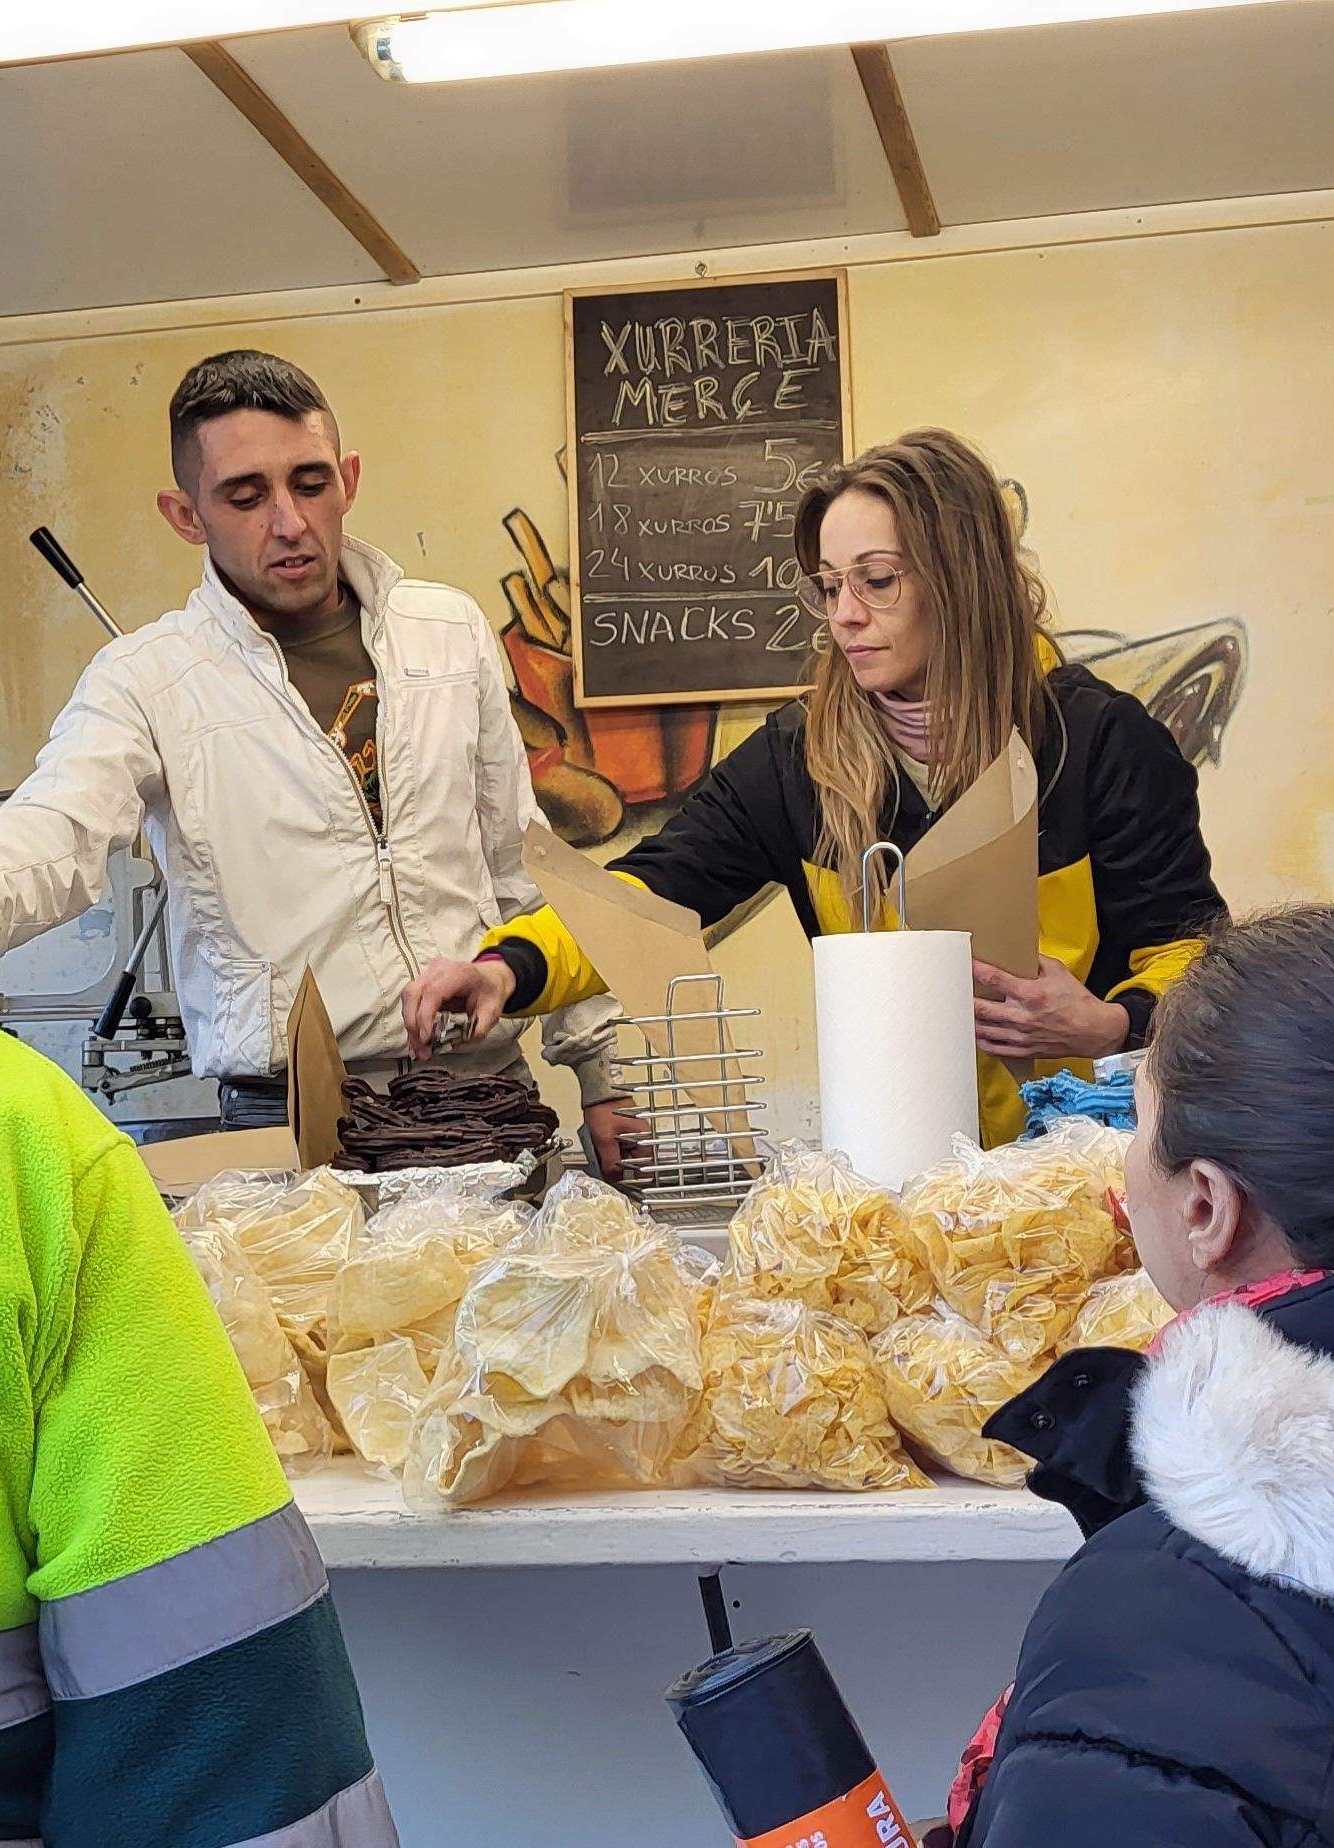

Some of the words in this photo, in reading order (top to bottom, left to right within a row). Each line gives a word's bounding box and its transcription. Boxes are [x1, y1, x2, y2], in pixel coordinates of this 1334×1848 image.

[600, 307, 837, 377] XURRERIA
[587, 452, 629, 489] 12
[638, 465, 738, 488] XURROS
[587, 503, 633, 535] 18
[638, 513, 731, 538] XURROS
[585, 548, 631, 581] 24
[638, 560, 737, 583] XURROS
[589, 606, 756, 648] SNACKS
